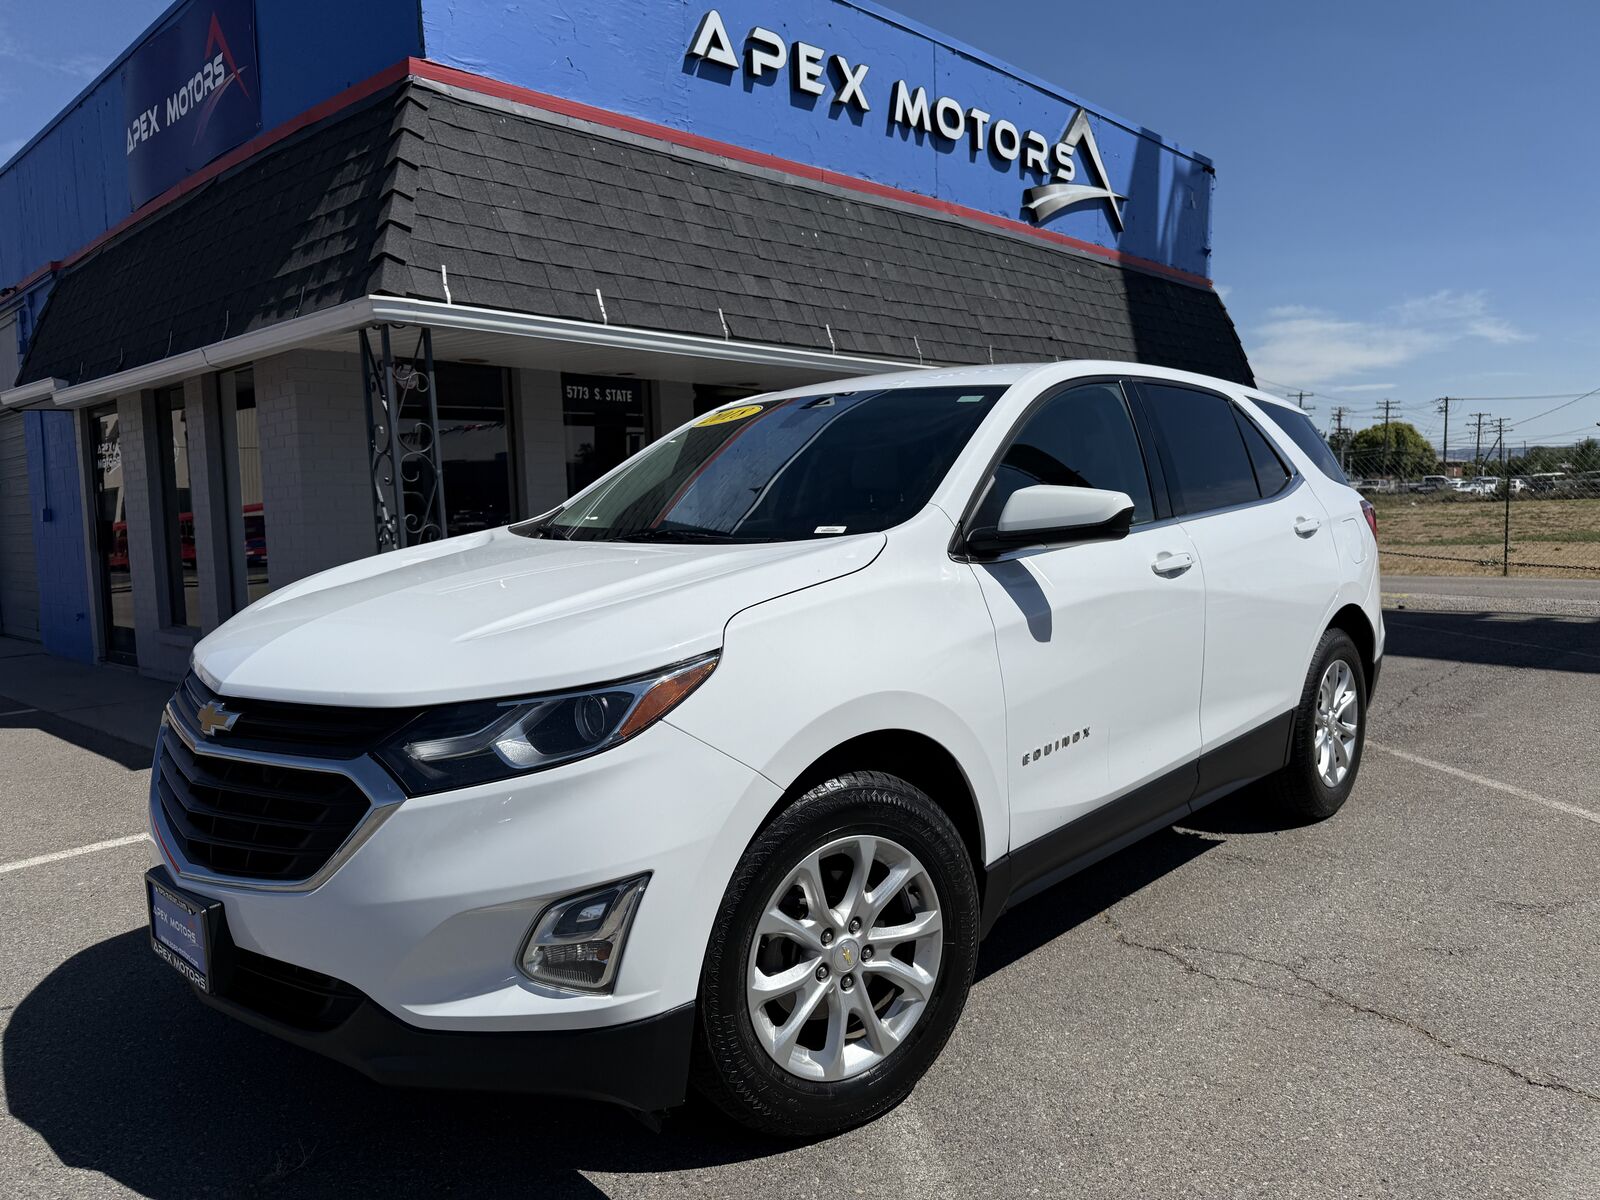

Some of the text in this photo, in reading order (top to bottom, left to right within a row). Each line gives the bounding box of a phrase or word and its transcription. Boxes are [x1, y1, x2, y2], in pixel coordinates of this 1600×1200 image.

[127, 51, 224, 155] APEX MOTORS
[687, 9, 1076, 183] APEX MOTORS
[566, 385, 633, 402] 5773 S. STATE
[1022, 726, 1090, 767] EQUINOX
[153, 904, 196, 944] APEX MOTORS
[153, 942, 206, 989] APEX MOTORS
